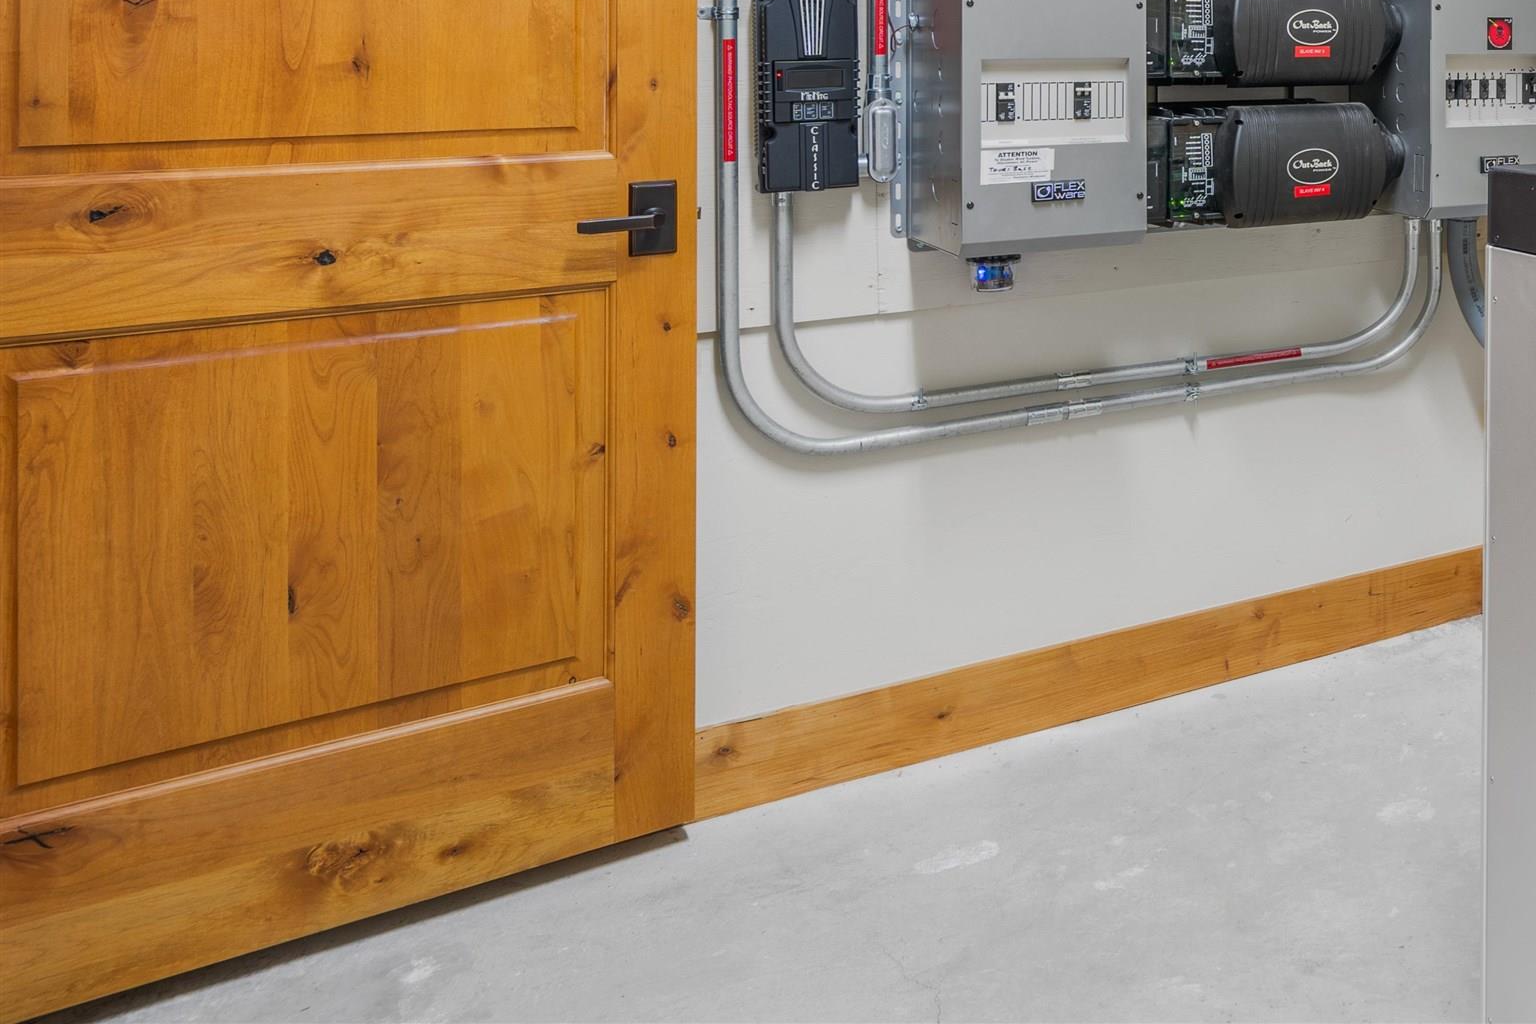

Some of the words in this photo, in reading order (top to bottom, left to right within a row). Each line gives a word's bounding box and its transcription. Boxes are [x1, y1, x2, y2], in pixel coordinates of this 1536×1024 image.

[1497, 156, 1520, 165] FLEX
[1053, 181, 1085, 192] FLEX
[1054, 189, 1086, 200] ware
